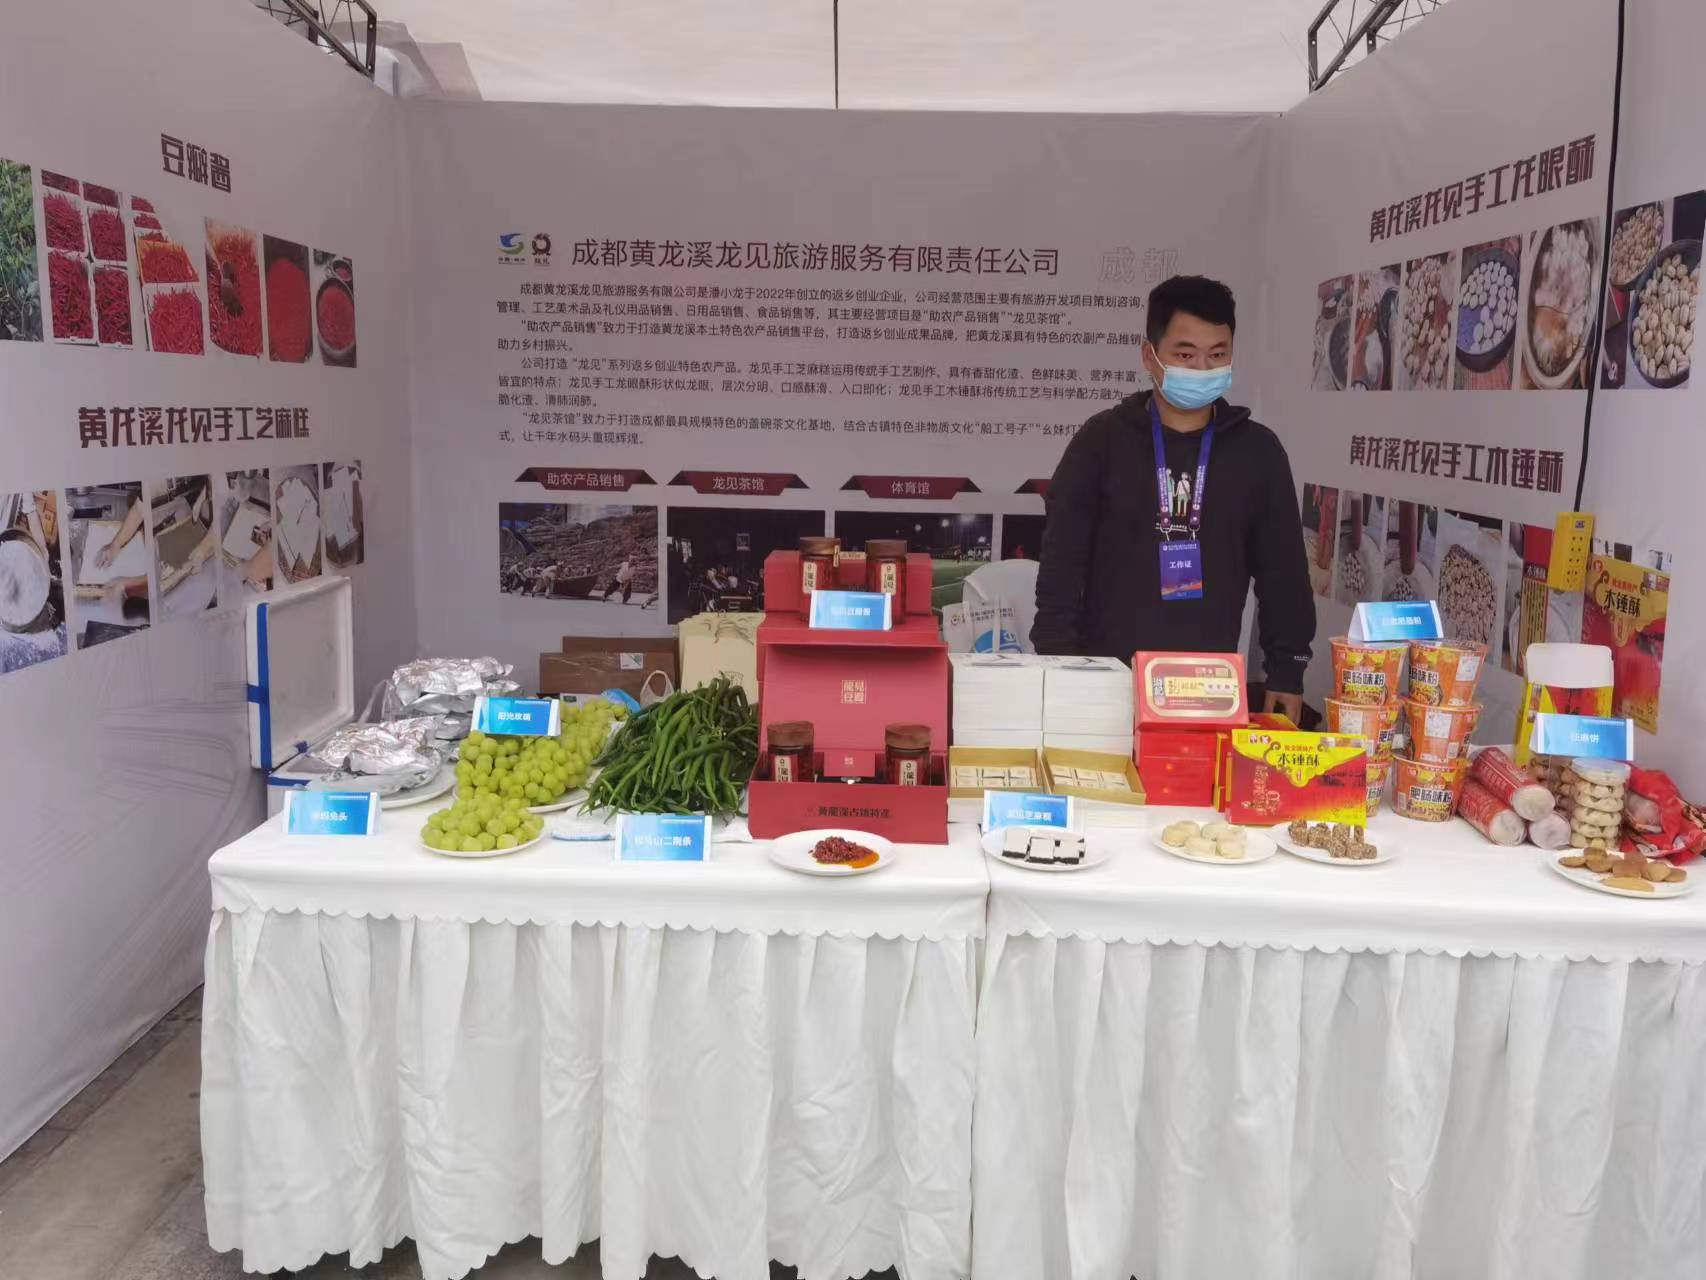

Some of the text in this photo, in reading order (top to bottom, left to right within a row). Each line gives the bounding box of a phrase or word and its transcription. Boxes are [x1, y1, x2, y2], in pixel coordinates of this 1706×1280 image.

[161, 133, 231, 193] 豆瓣酱
[1369, 133, 1597, 243] 黄龙溪龙见手工龙眼酥
[572, 238, 1059, 277] 成都黄龙溪龙见旅游服务有限责任公司
[498, 338, 574, 352] 助力乡村振兴。
[78, 407, 310, 448] 黄龙溪龙见手工芝麻糕
[1350, 434, 1564, 493] 黄龙溪龙见手工木锤酥
[547, 472, 625, 488] 助农产品销售
[712, 476, 764, 490] 龙见茶馆
[891, 481, 930, 495] 体育馆
[1169, 559, 1193, 569] 工作证
[1604, 588, 1641, 617] 木锤酥
[497, 710, 532, 722] 阳光玫瑰
